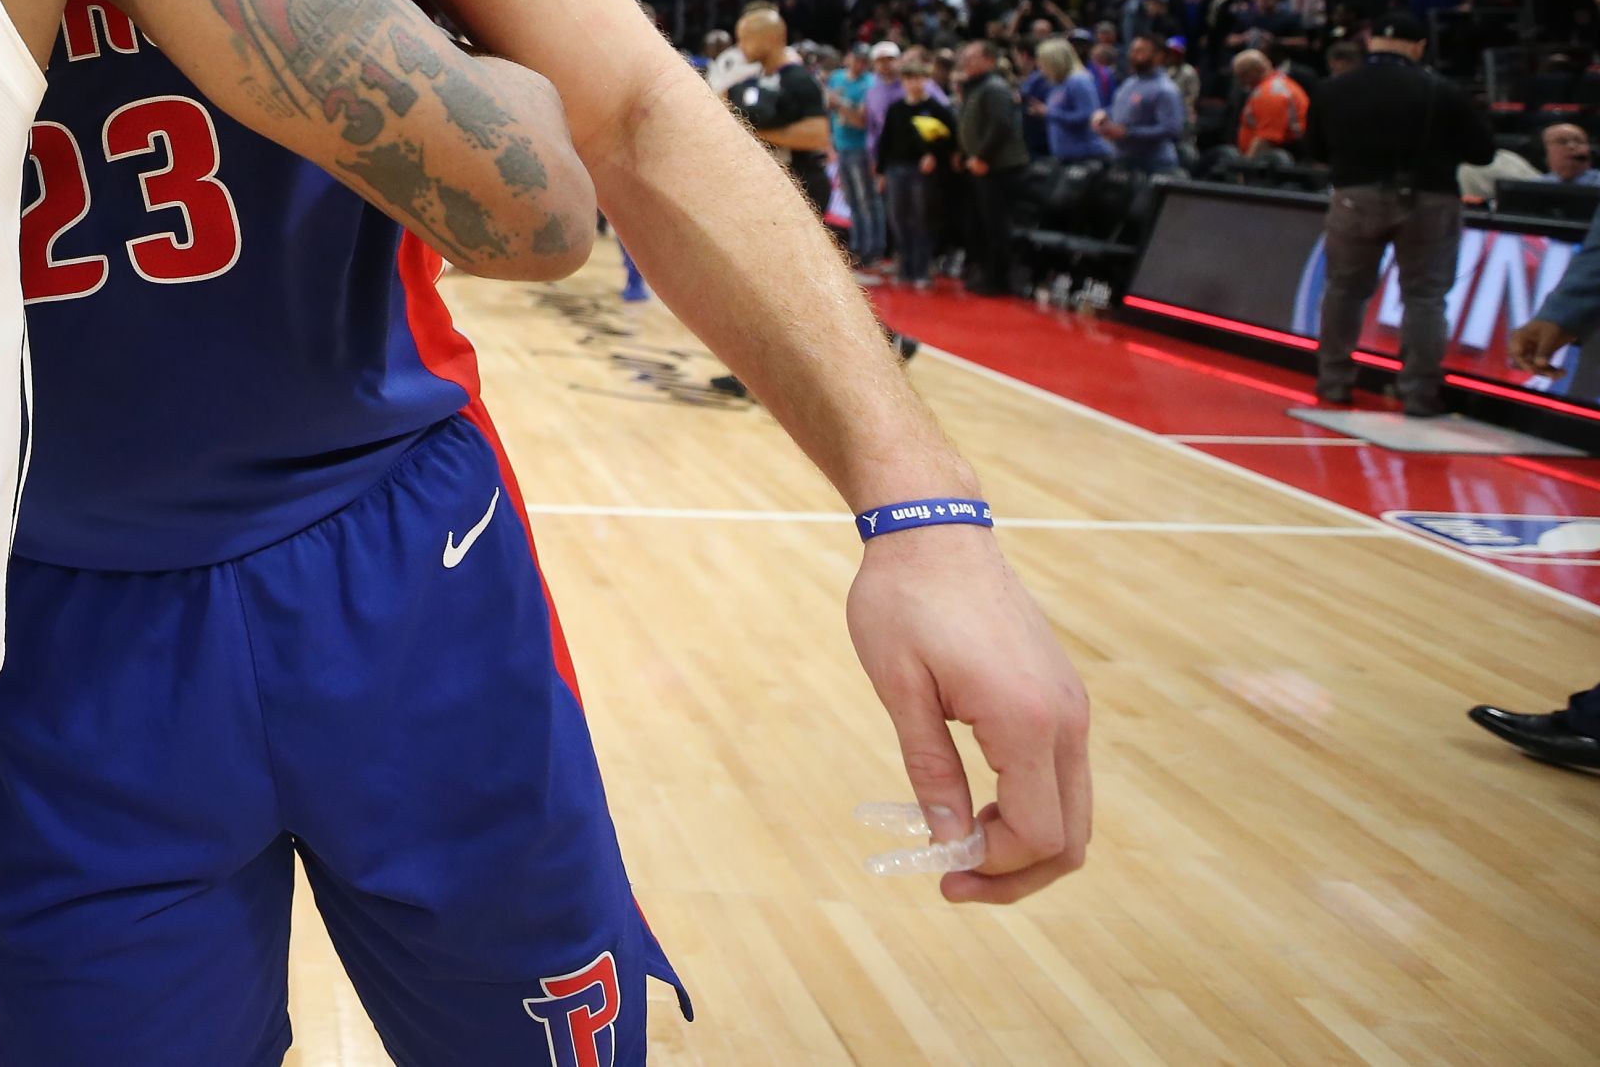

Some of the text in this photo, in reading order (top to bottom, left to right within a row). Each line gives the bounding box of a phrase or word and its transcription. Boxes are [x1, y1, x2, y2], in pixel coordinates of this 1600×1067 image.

[20, 94, 243, 305] 23
[891, 504, 932, 521] finn
[935, 503, 946, 516] +
[948, 502, 977, 518] ford
